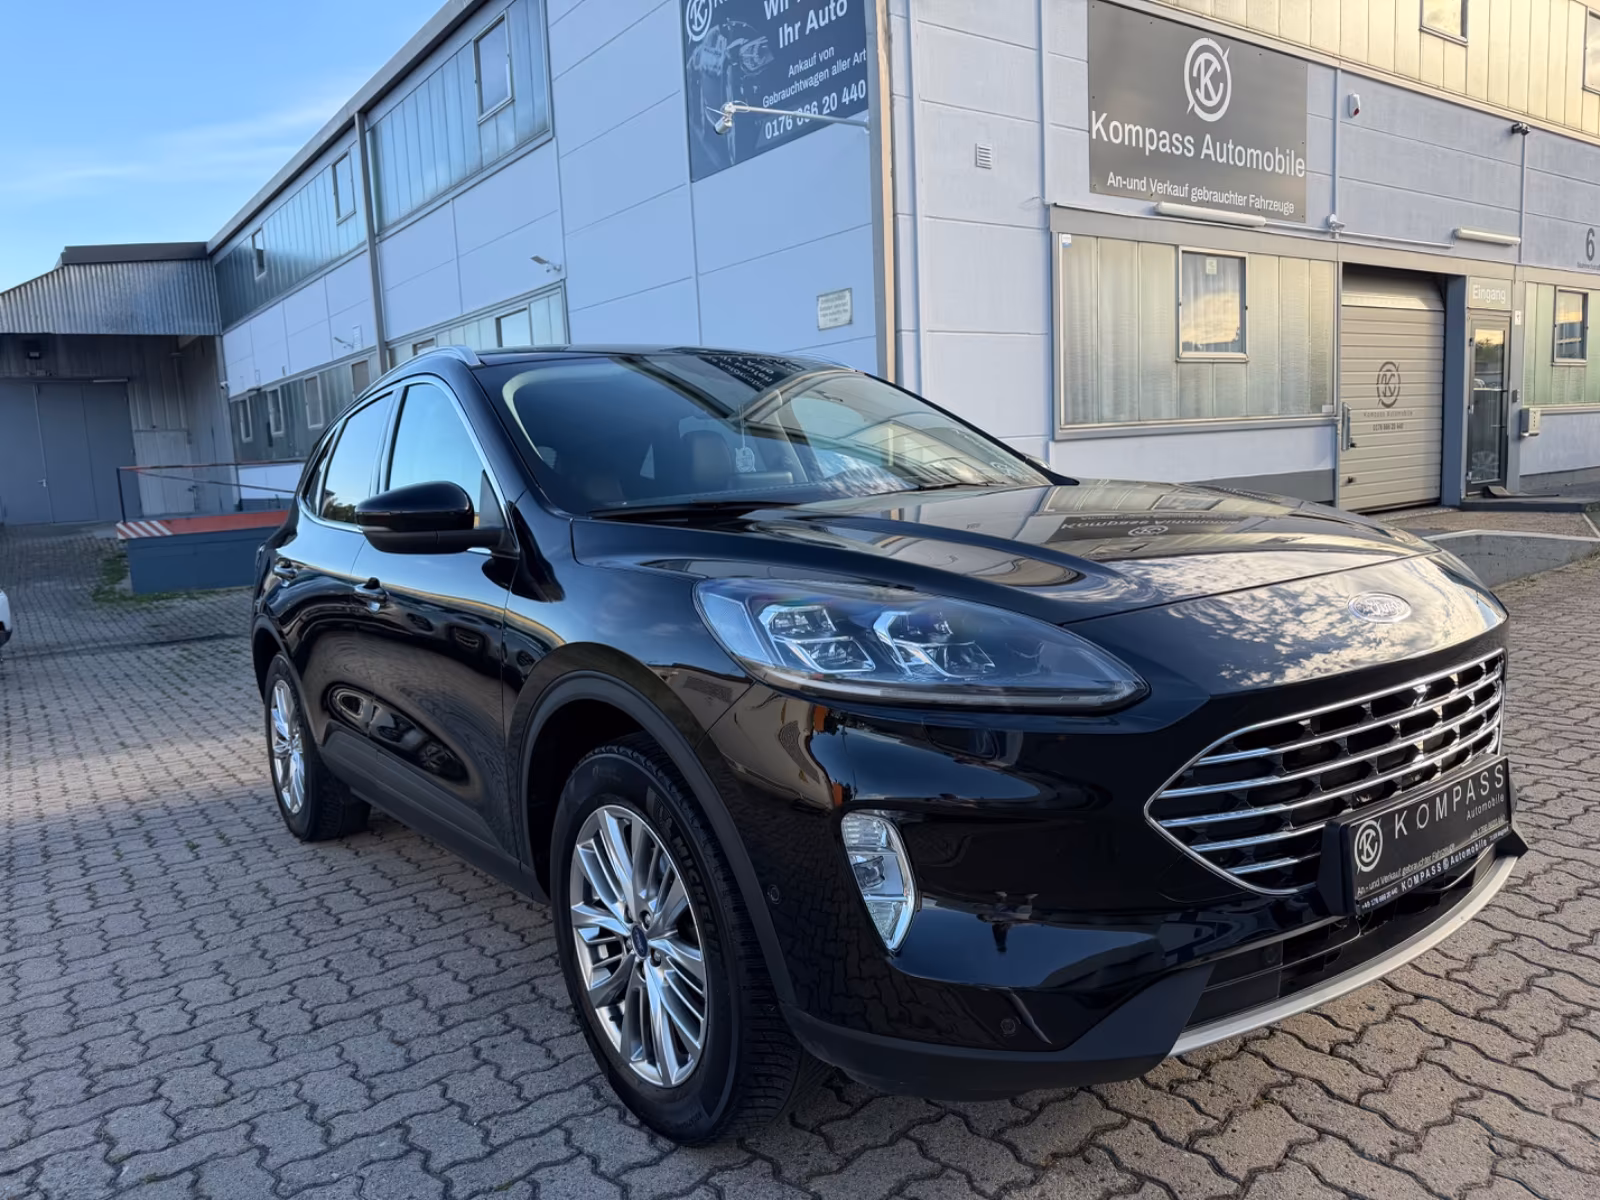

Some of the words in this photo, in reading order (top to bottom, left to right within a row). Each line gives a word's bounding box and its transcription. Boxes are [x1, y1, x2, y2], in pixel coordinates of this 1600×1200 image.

[778, 21, 801, 49] Ihr
[805, 0, 848, 35] Auto
[762, 67, 830, 108] Gebrauchtwagen
[831, 60, 851, 78] aller
[852, 48, 867, 68] Art
[788, 52, 817, 78] Ankauf
[818, 46, 835, 62] von
[821, 92, 838, 115] 20
[841, 79, 866, 105] 440
[1091, 110, 1195, 158] Kompass
[1200, 133, 1305, 178] Automobile
[1107, 171, 1147, 192] An-und
[1149, 178, 1190, 198] Verkauf
[1190, 186, 1248, 208] gebrauchter
[1248, 194, 1294, 216] Fahrzeuge
[1586, 227, 1595, 262] 6
[1473, 284, 1506, 305] Eingang
[1393, 763, 1504, 839] KOMPASS
[1466, 792, 1505, 821] Automobile
[1401, 862, 1442, 892] KOMPASS
[1450, 838, 1487, 866] Automobile
